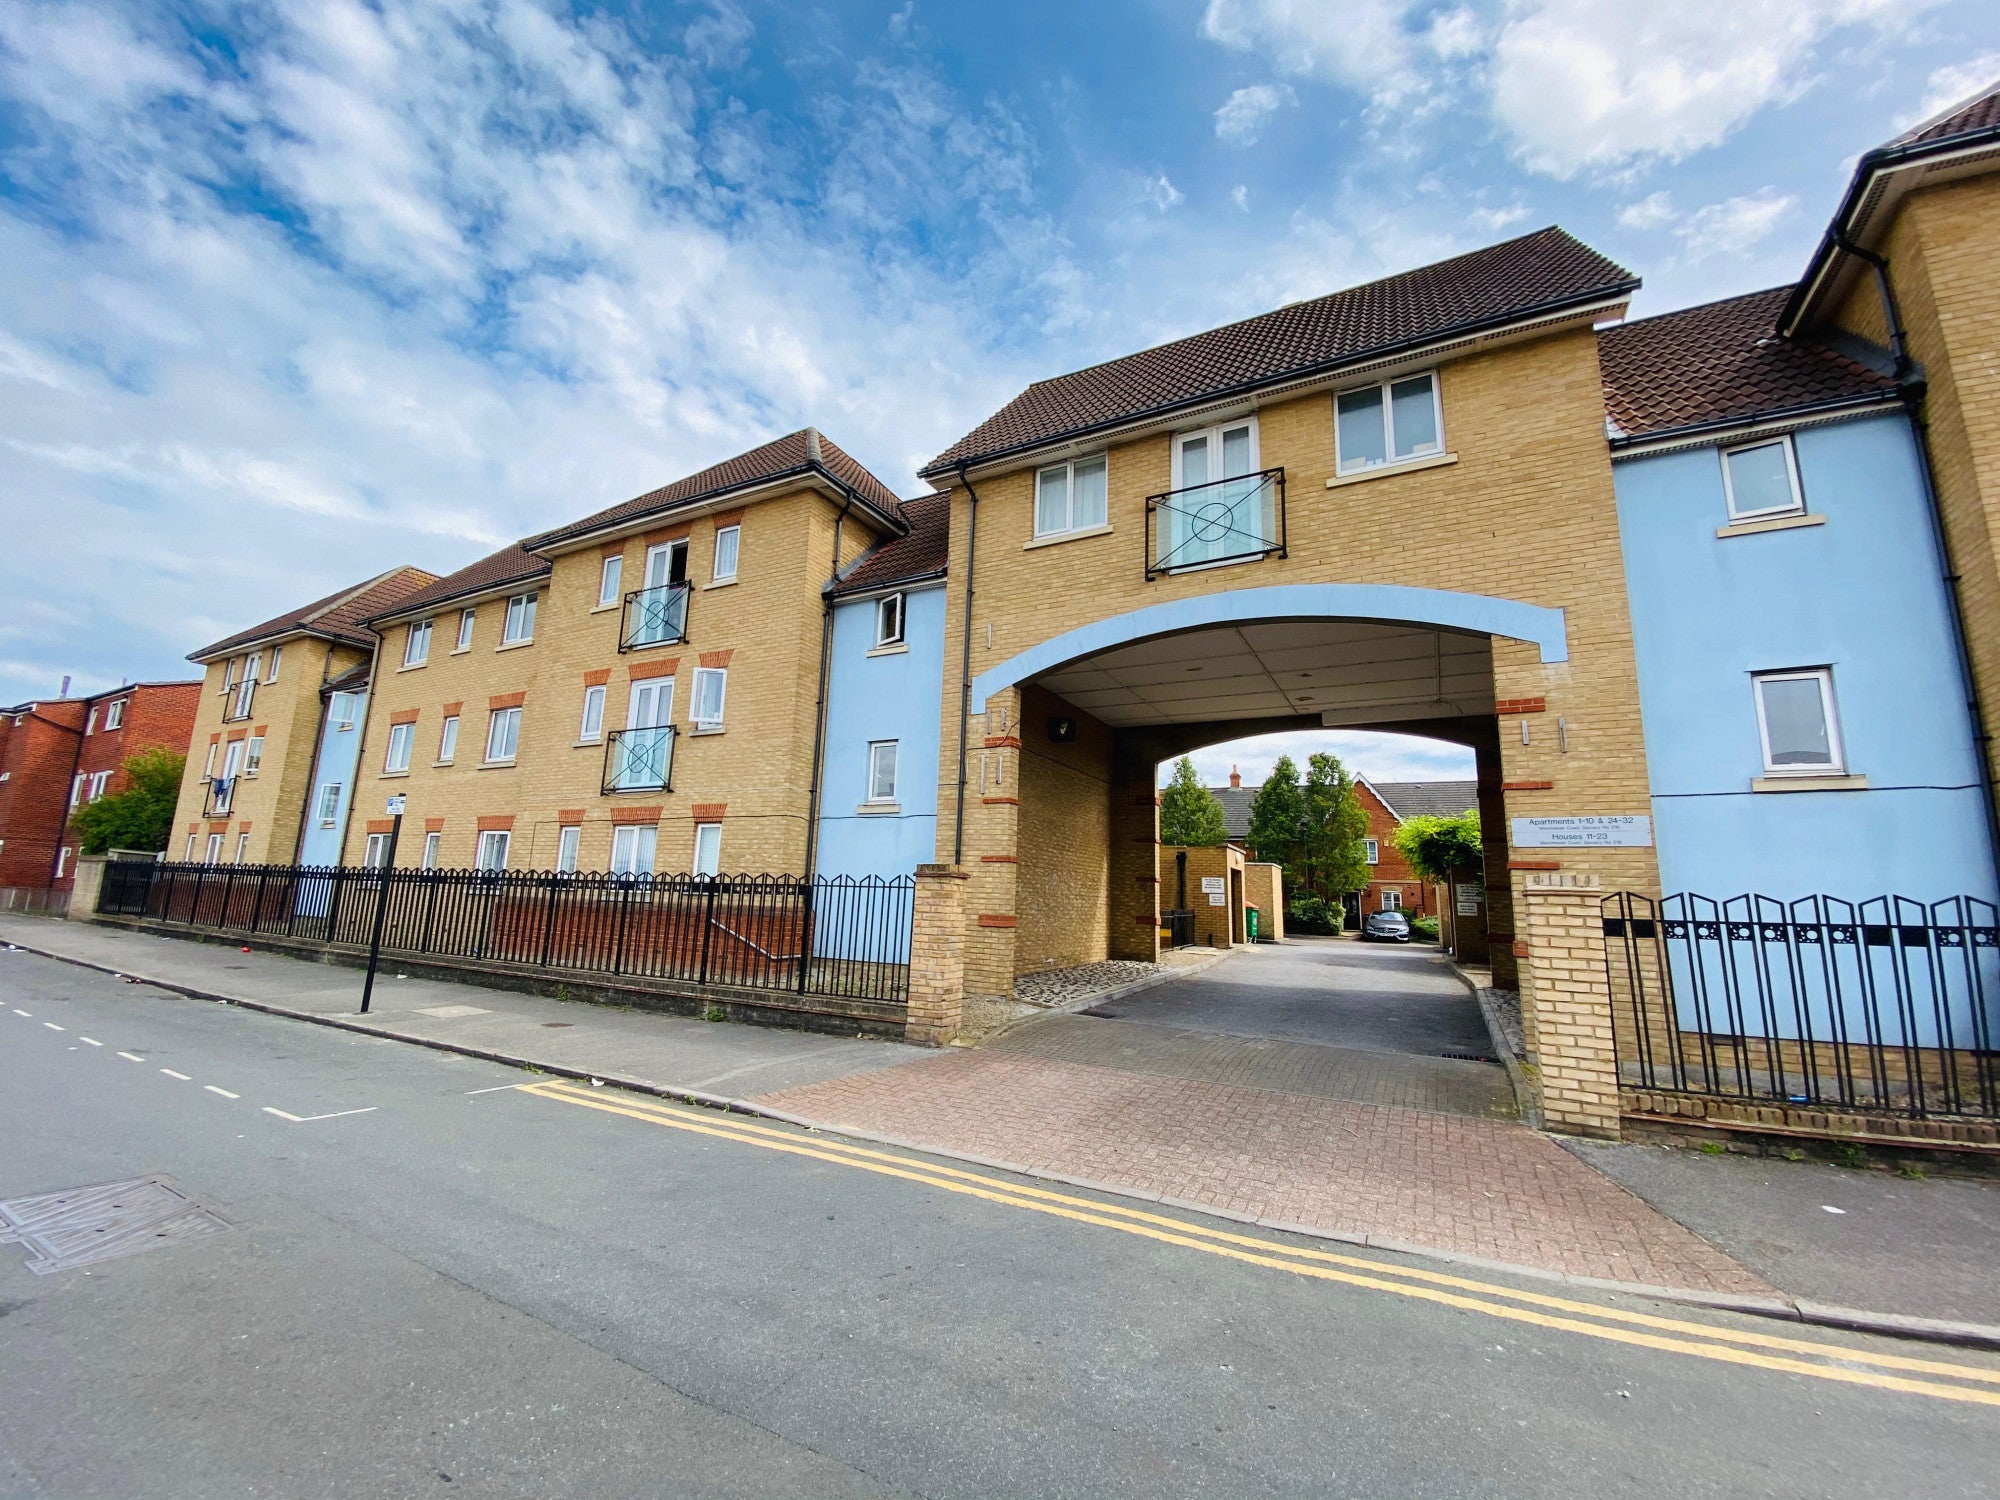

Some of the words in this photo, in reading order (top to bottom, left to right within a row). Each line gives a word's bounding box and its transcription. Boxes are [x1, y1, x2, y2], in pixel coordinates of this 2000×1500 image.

[1529, 818, 1575, 826] Apartments
[1578, 817, 1595, 825] 1-10
[1607, 816, 1634, 824] 24-32
